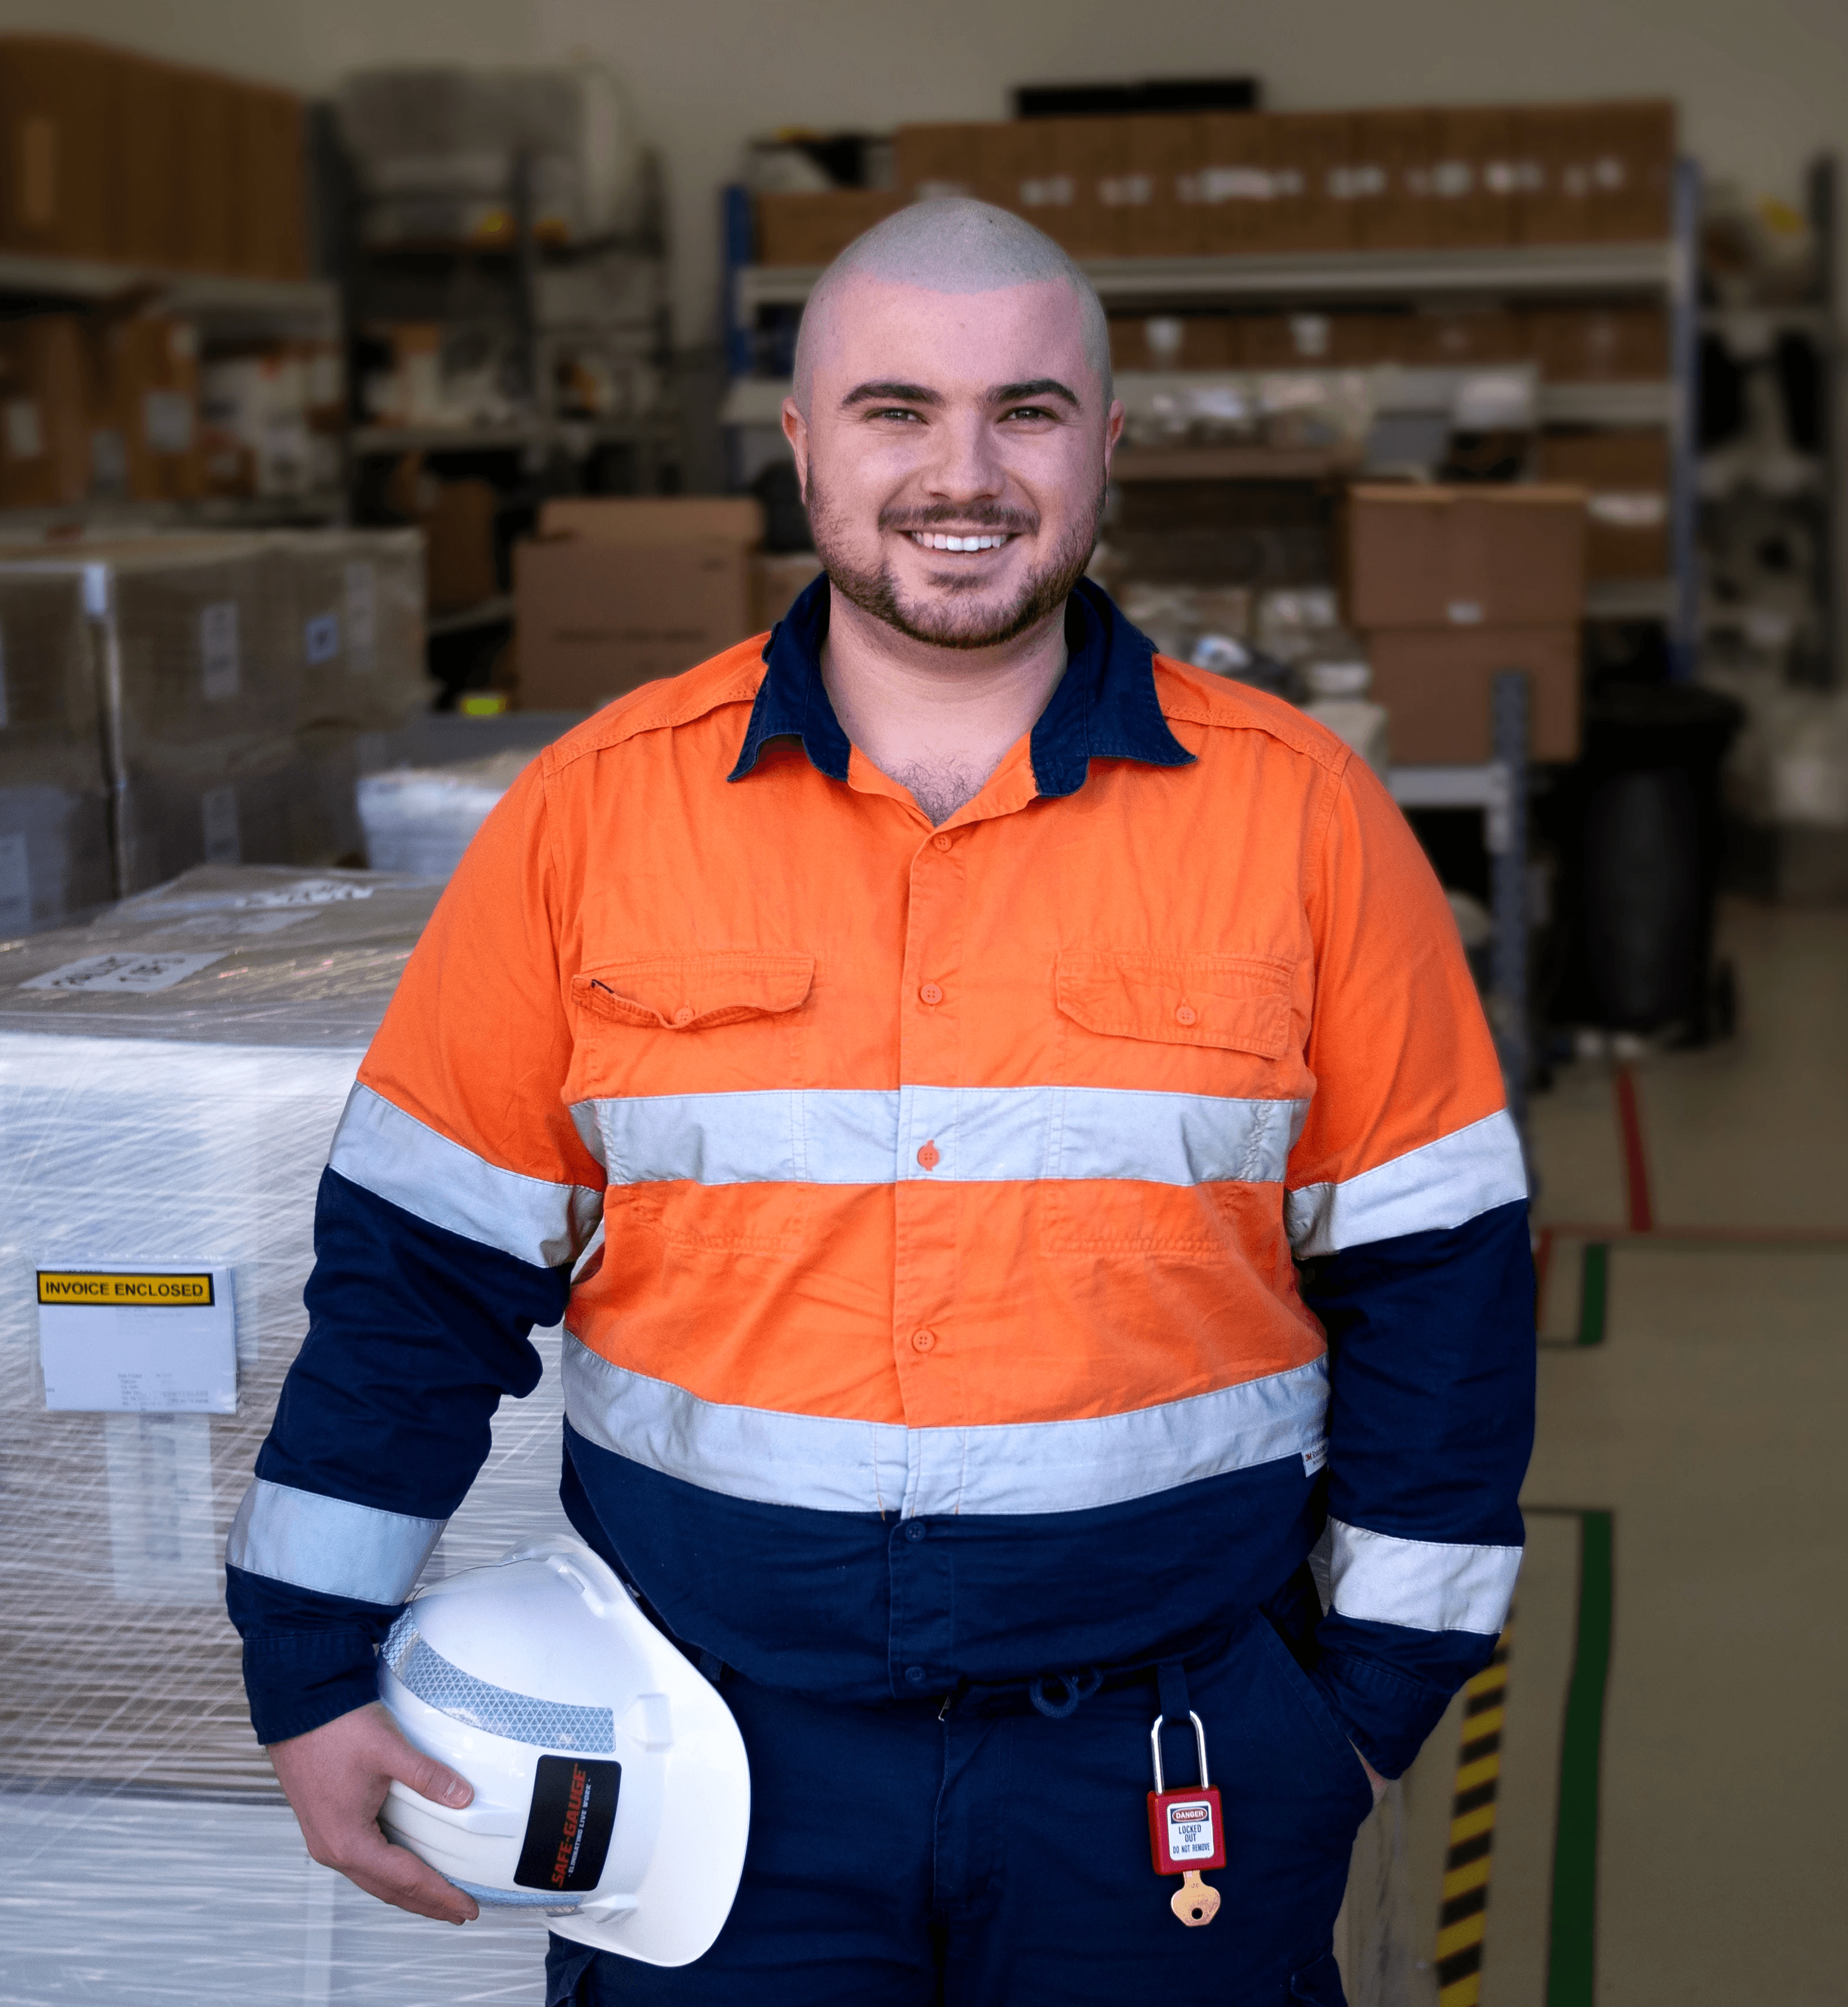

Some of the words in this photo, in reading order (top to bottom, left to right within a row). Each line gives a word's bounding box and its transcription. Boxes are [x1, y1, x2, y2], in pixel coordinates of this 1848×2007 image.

[46, 1282, 110, 1296] INVOICE
[114, 1282, 203, 1297] ENCLOSED
[579, 1810, 587, 1828] LIVE
[583, 1783, 591, 1808] WORK
[1176, 1810, 1204, 1819] DANGER
[552, 1763, 585, 1887] SAFE-GAUGE
[1179, 1824, 1201, 1834] LOCKED
[1184, 1834, 1196, 1842] OUT
[1173, 1846, 1179, 1854] DO
[1181, 1844, 1190, 1853] NOT
[1192, 1843, 1210, 1852] REMOVE
